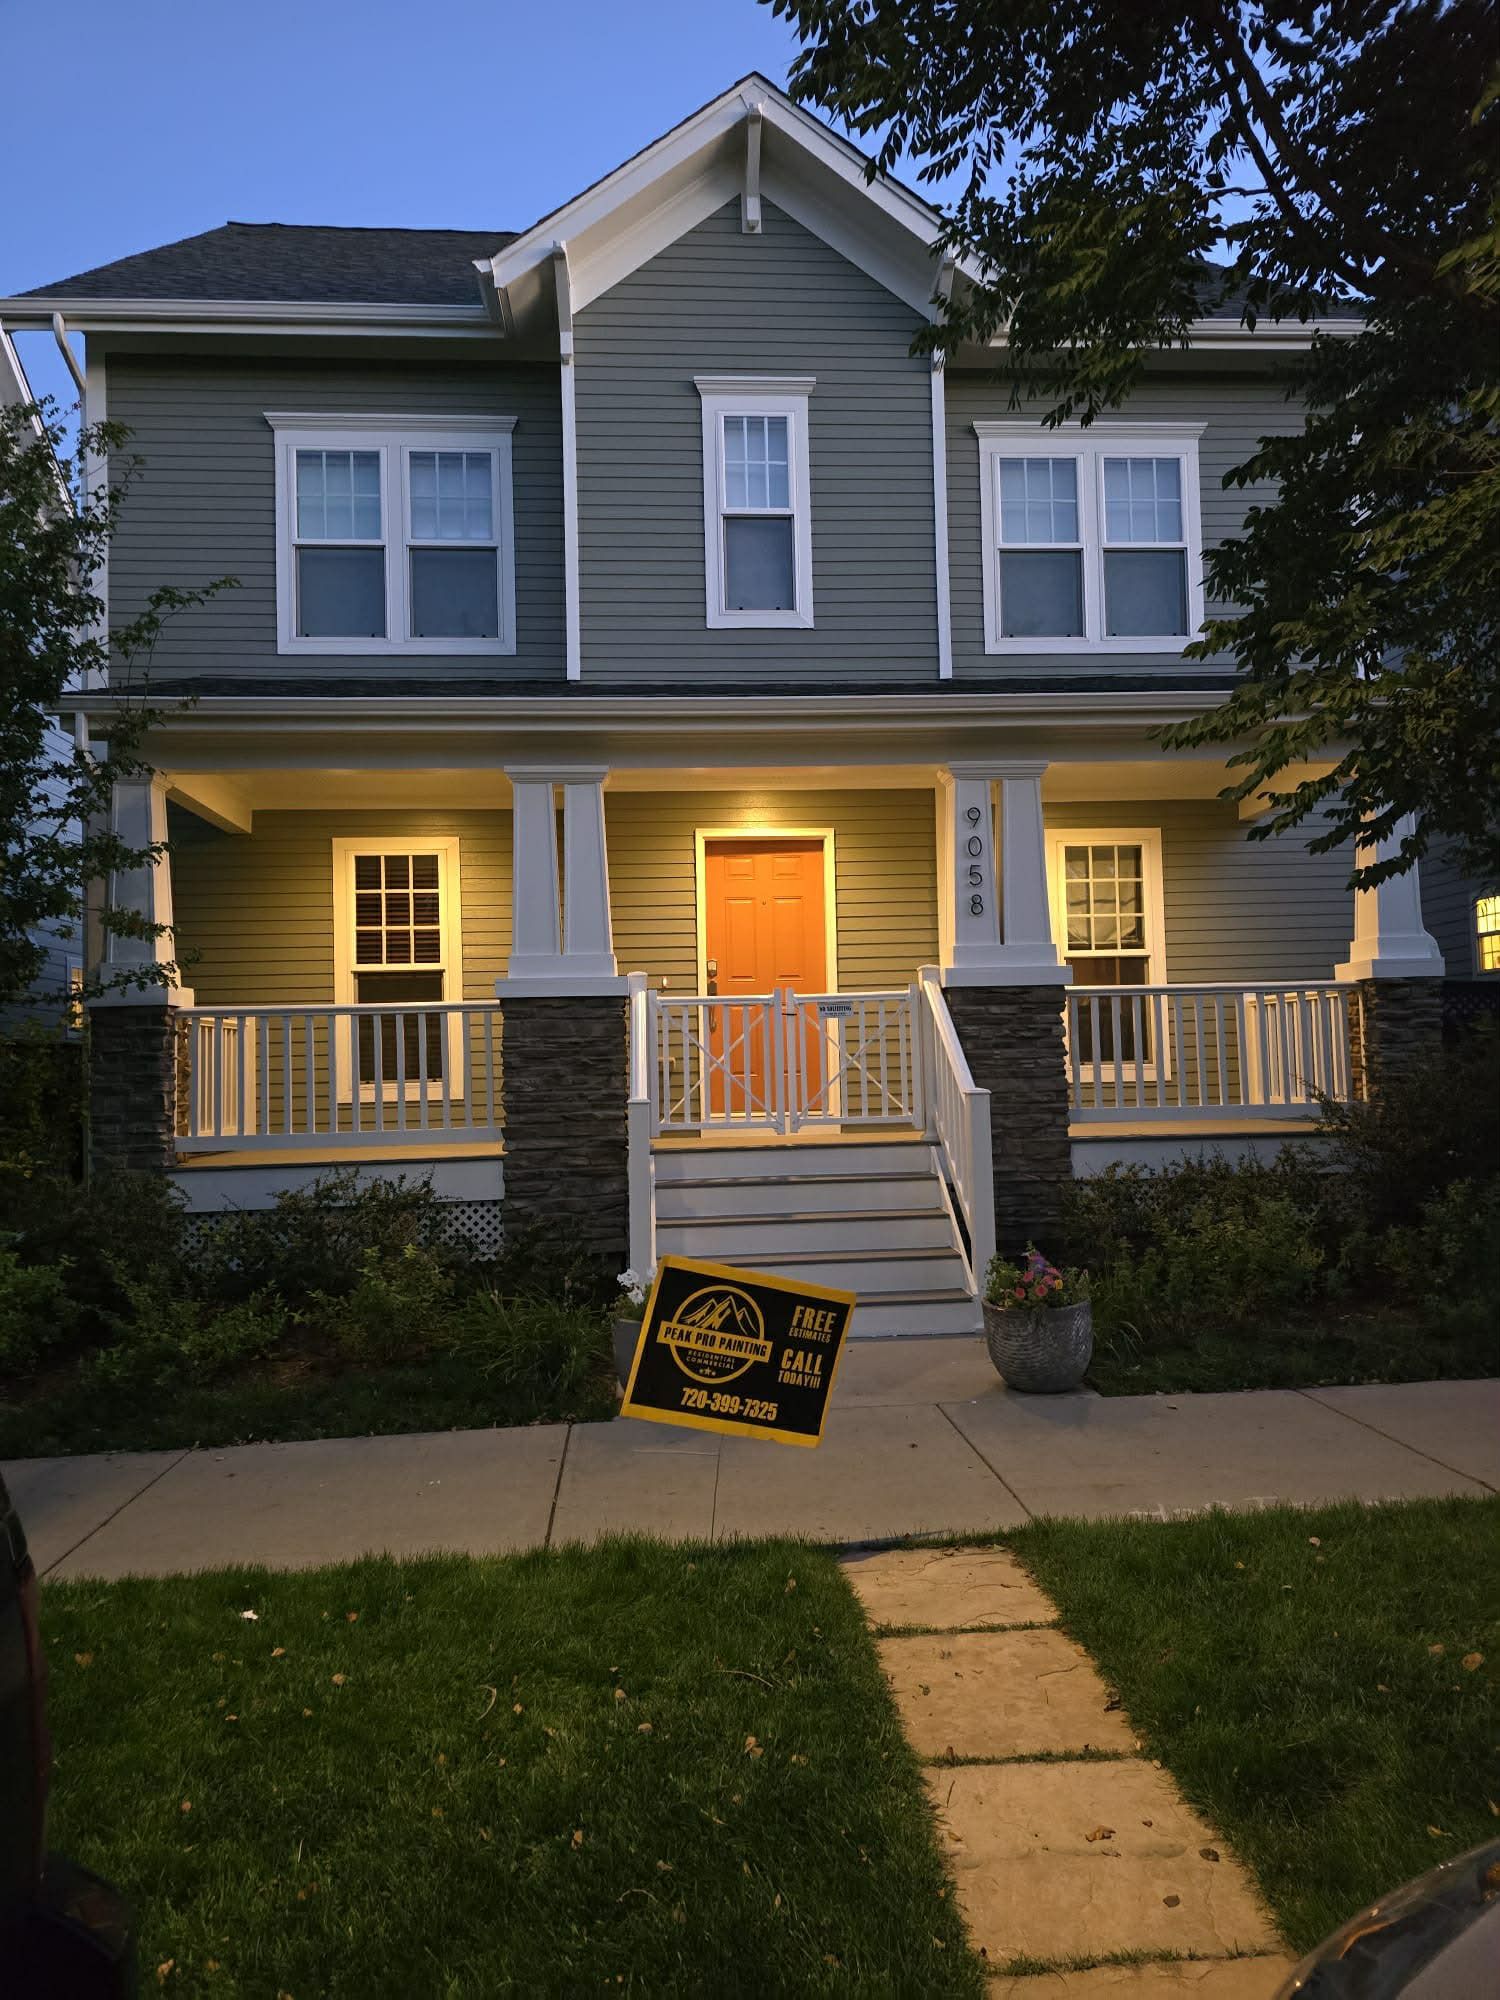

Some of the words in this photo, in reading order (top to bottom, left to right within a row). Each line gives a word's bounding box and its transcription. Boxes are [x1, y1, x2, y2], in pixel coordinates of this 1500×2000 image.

[967, 807, 984, 915] 9058
[791, 1305, 837, 1333] FREE
[664, 1326, 692, 1343] PEAK
[695, 1331, 717, 1348] PRO
[719, 1337, 768, 1357] PAINTING
[788, 1327, 832, 1343] ESTIMATES
[686, 1356, 735, 1370] COMMERCIAL
[687, 1350, 735, 1364] RESIDENTIAL
[781, 1348, 823, 1375] CALL
[680, 1387, 779, 1421] 720-399-7325
